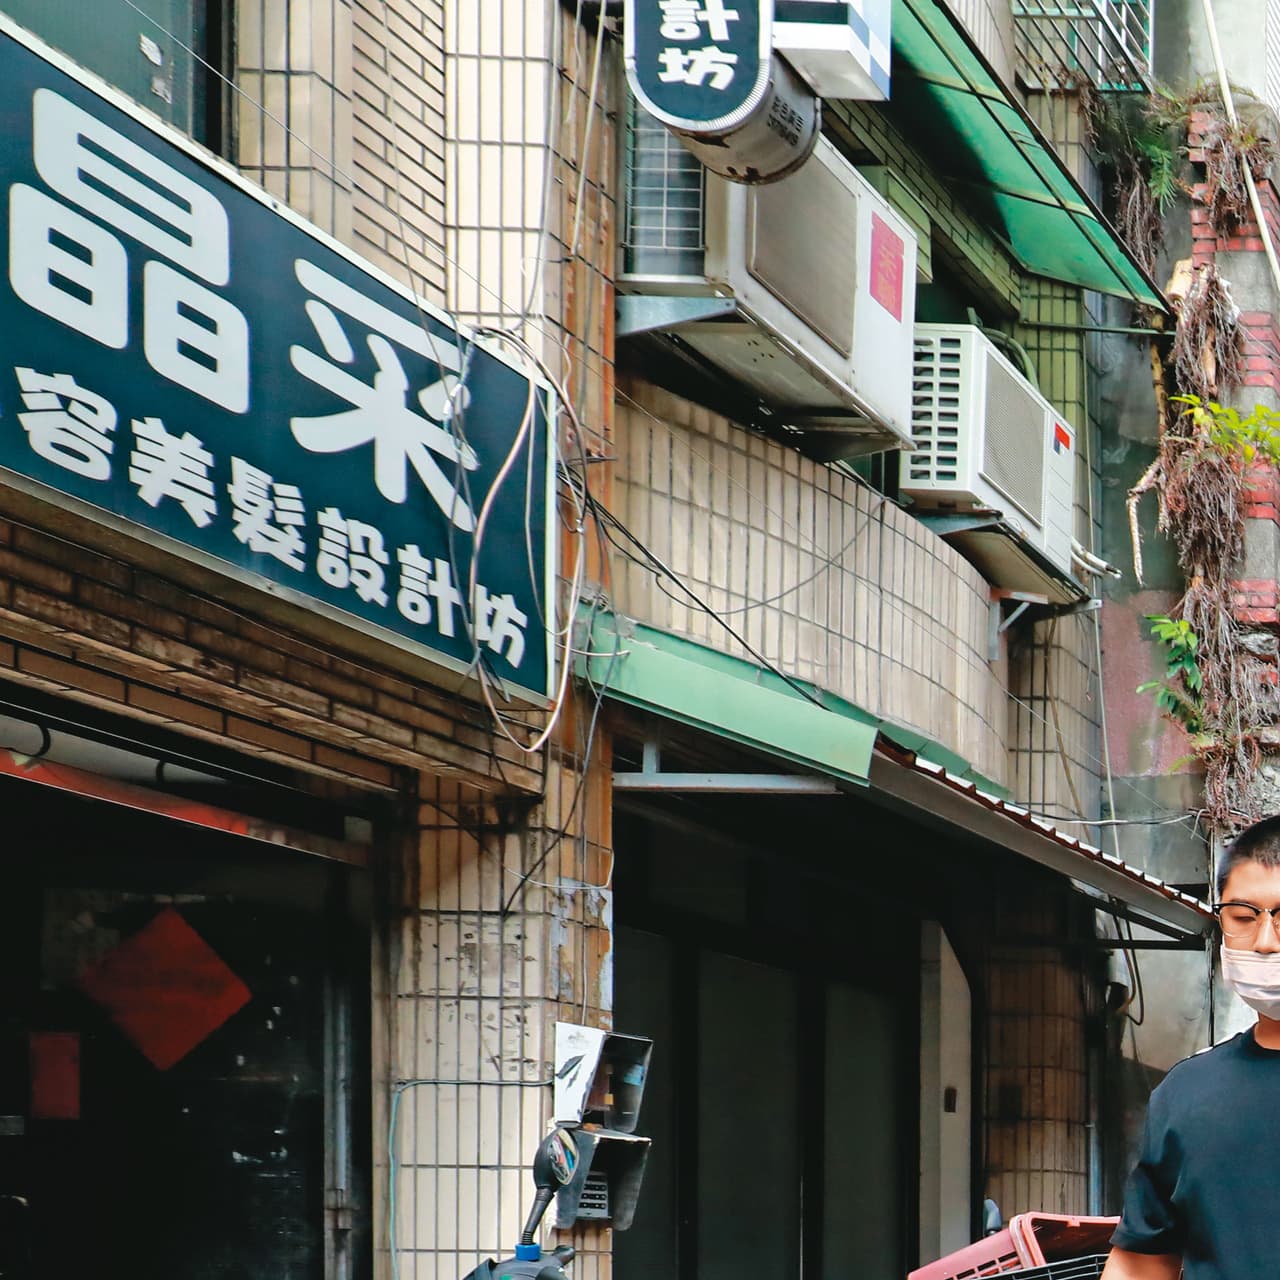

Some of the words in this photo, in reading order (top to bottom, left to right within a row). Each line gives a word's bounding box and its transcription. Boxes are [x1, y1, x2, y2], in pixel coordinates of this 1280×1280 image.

[8, 87, 479, 533] 晶采
[14, 366, 529, 669] 容美髮設計坊
